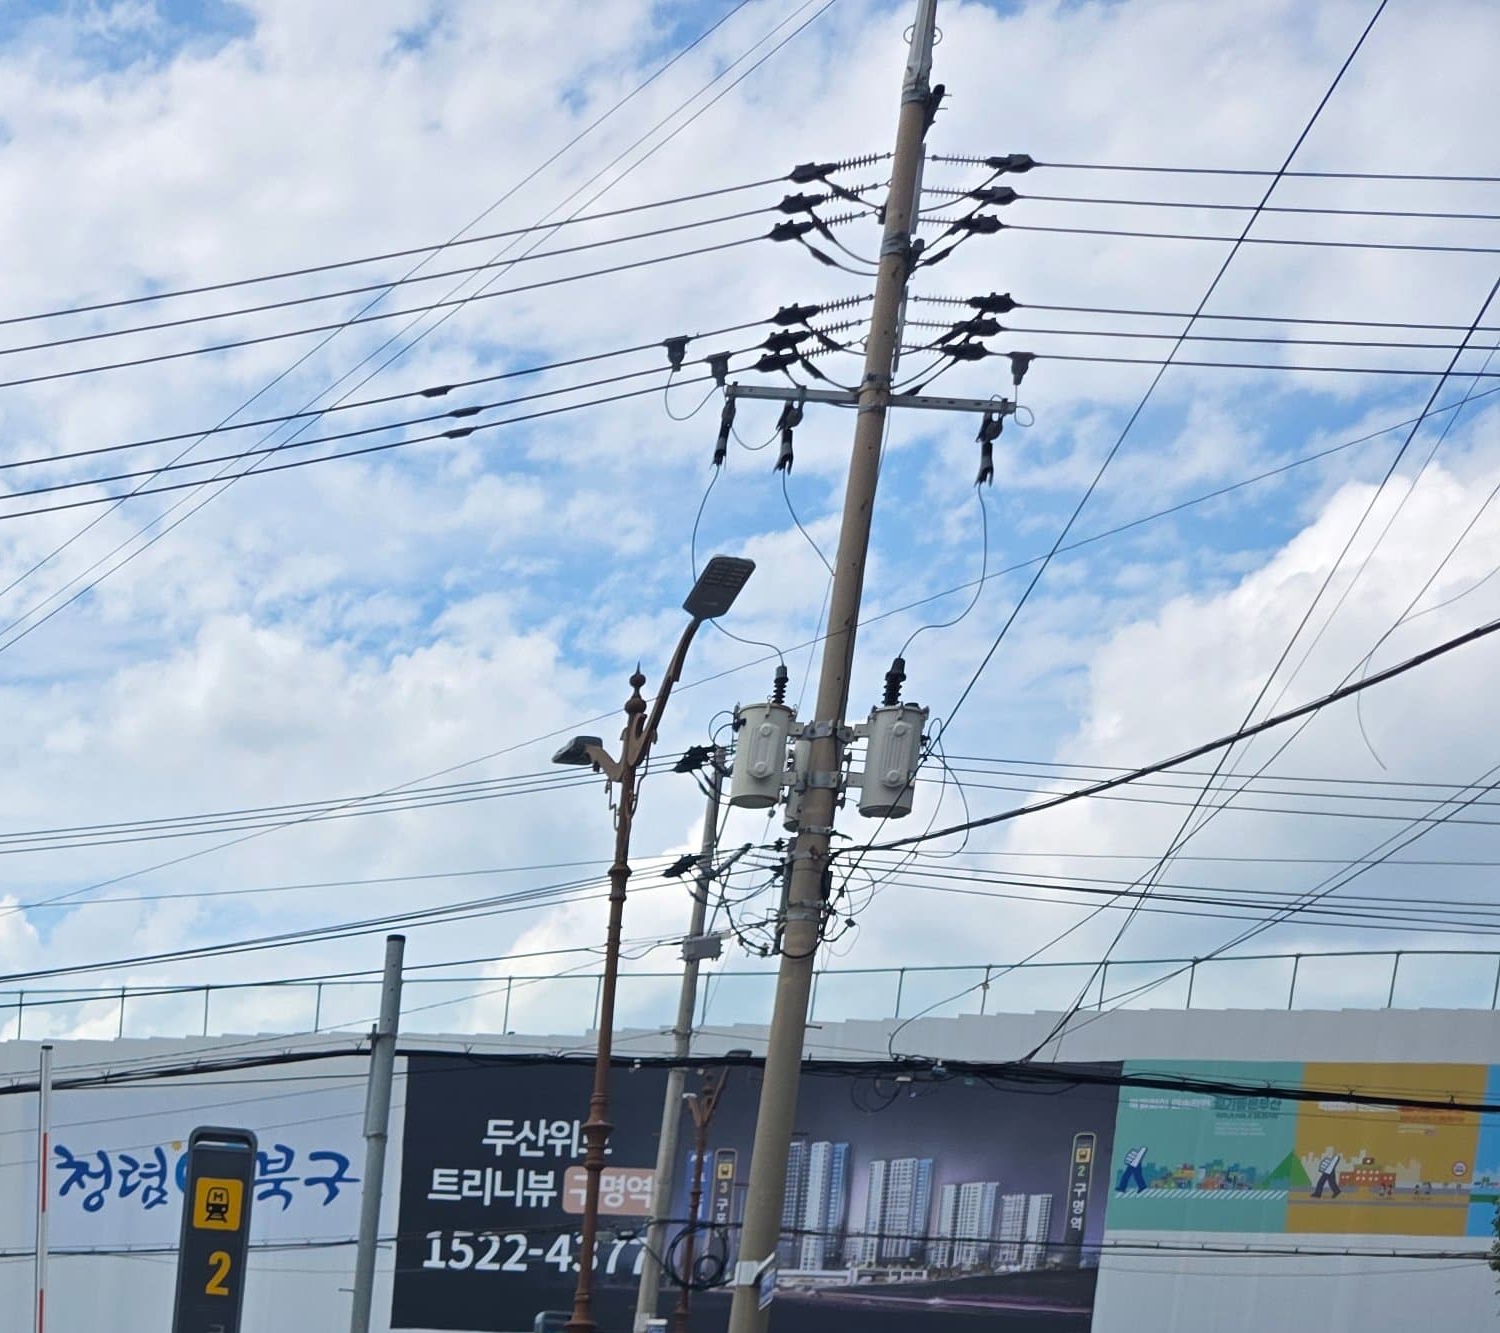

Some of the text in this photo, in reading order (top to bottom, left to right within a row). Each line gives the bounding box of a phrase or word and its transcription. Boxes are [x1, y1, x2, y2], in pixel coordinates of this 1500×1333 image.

[54, 1143, 360, 1212] 청렴 북구
[427, 1167, 557, 1208] 트리니뷰
[205, 1251, 232, 1296] 2
